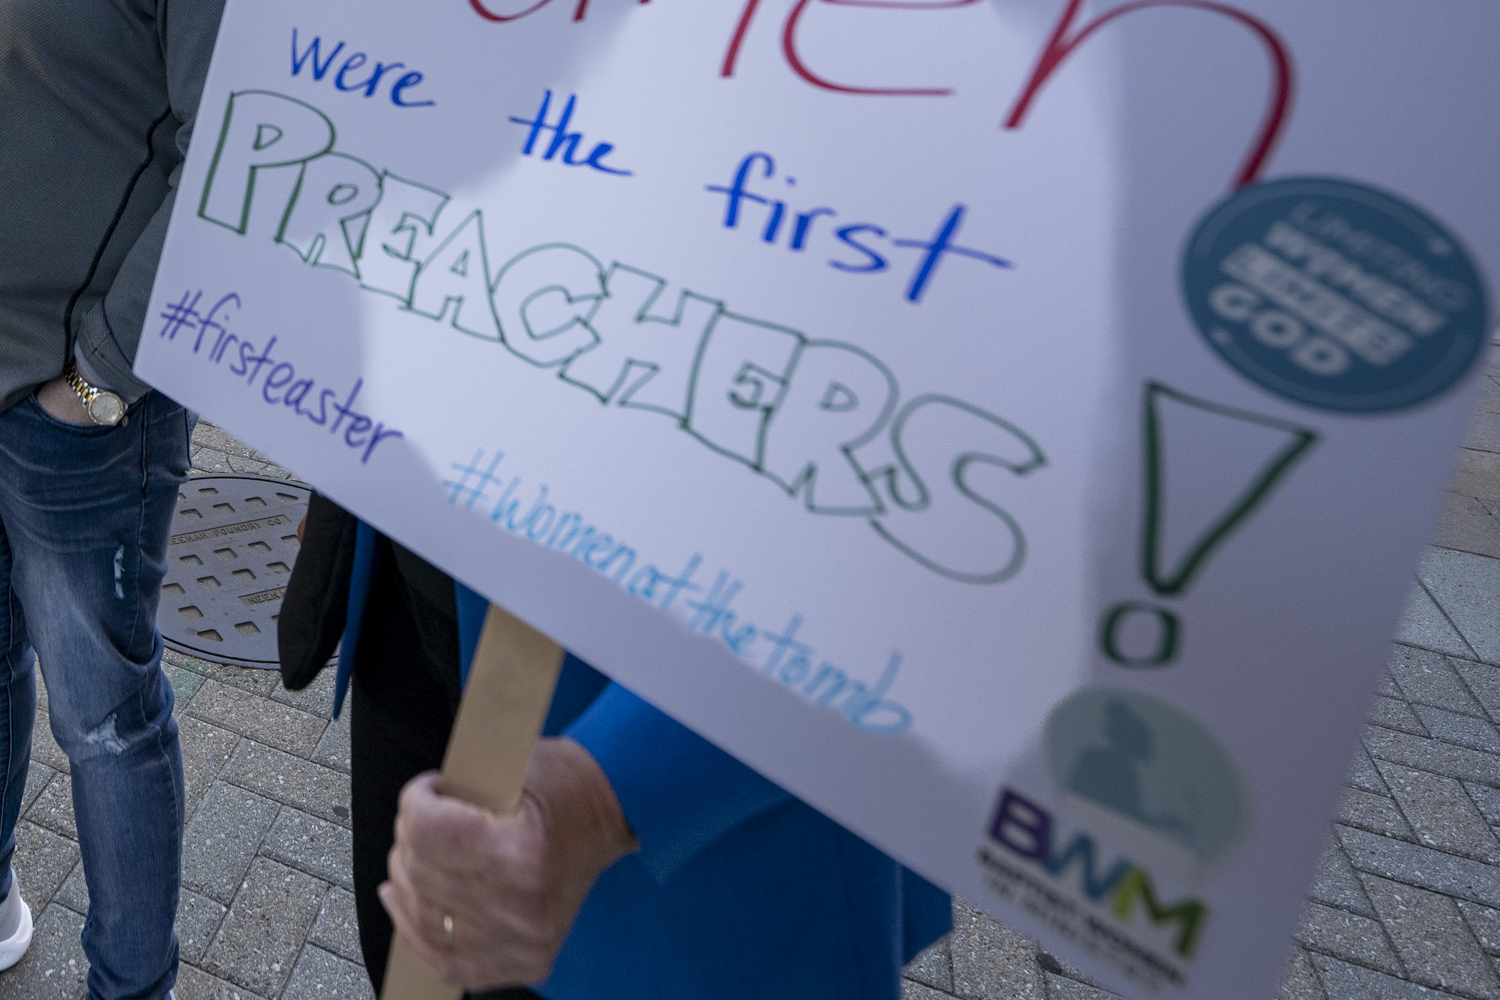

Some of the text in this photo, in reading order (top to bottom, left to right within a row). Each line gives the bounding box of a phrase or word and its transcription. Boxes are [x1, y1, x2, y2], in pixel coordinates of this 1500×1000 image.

[508, 89, 636, 176] the
[705, 152, 1015, 303] first
[197, 89, 1047, 584] PREACHERS
[1208, 283, 1350, 377] GOD
[169, 531, 207, 547] EENAH
[214, 521, 262, 538] FOUNDRY
[246, 590, 286, 606] NEENA
[988, 786, 1210, 960] BWM
